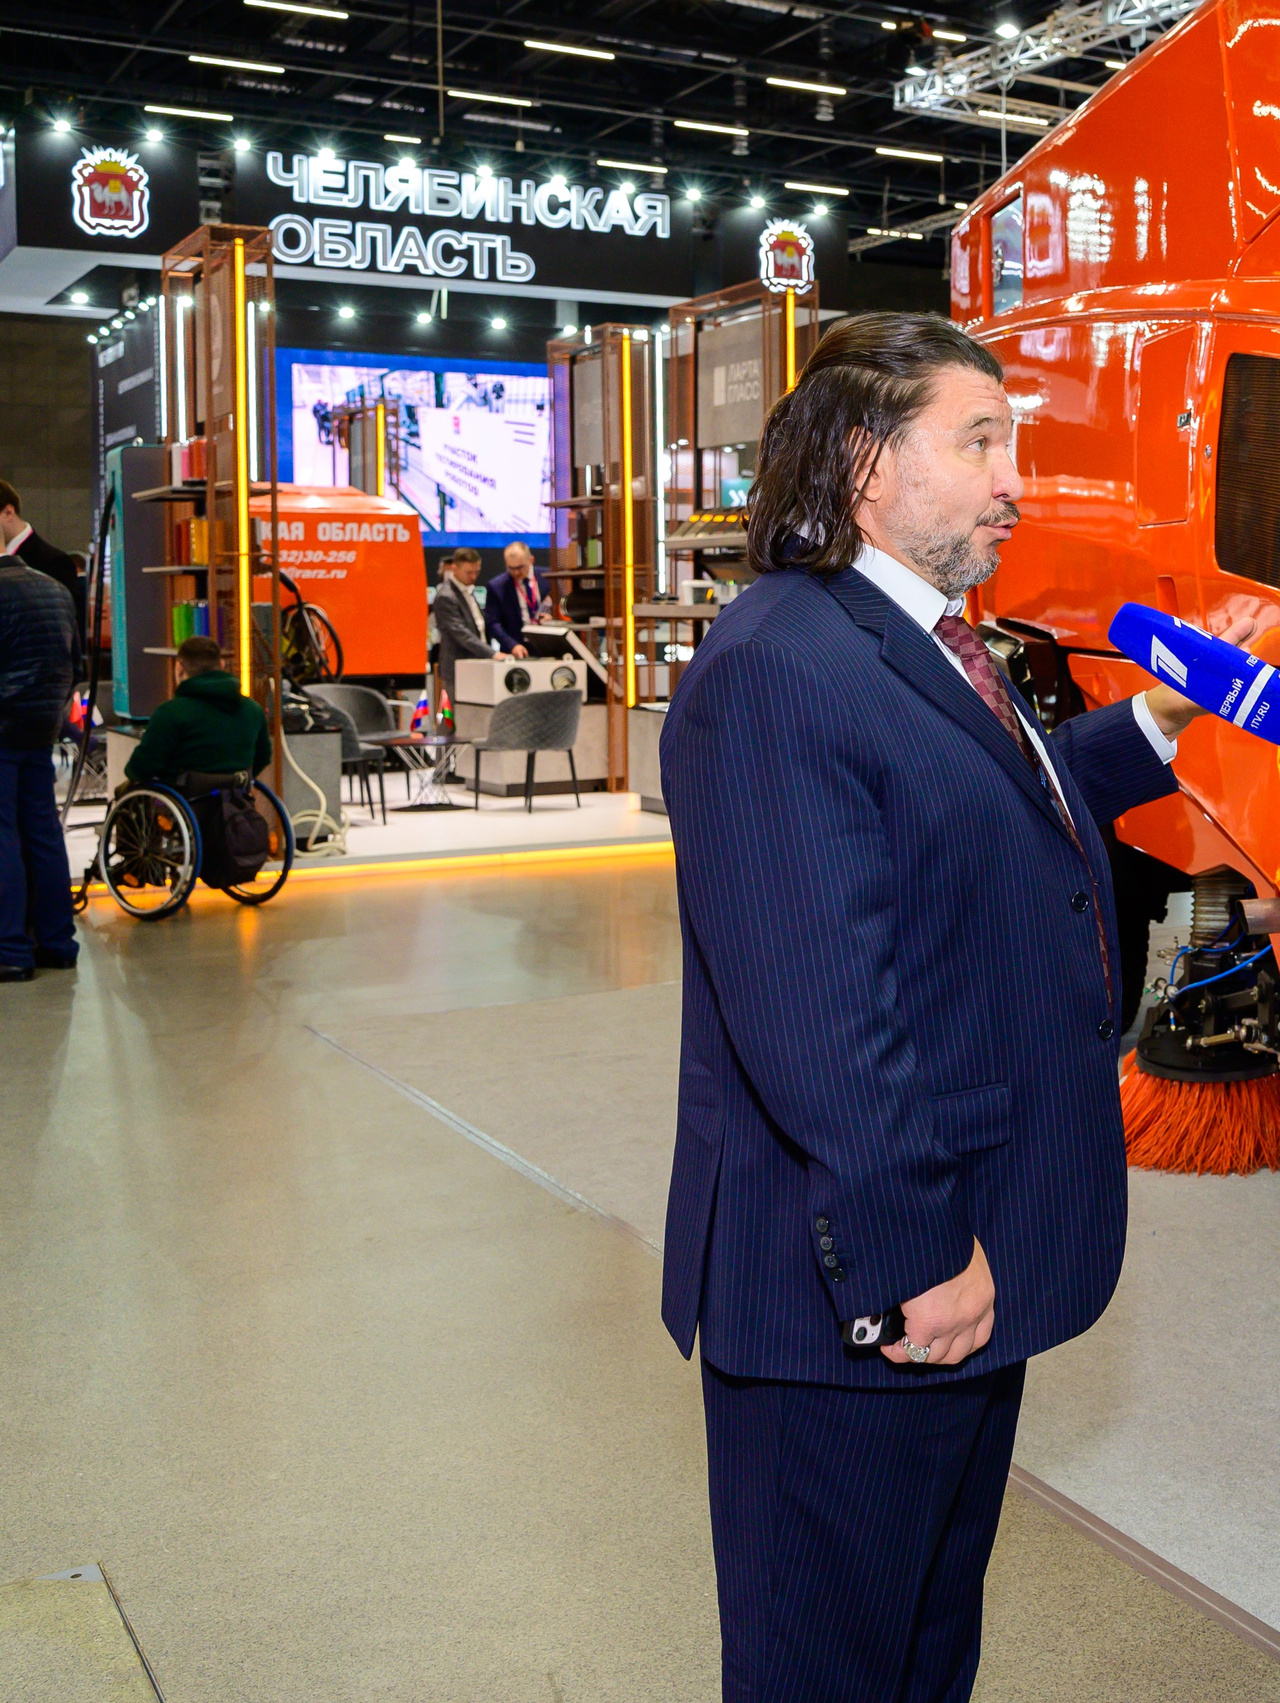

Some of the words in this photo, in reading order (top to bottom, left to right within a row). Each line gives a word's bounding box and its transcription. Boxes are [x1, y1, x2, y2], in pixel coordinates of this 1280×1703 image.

[267, 152, 671, 238] ЧЕЛЯБИНСКАЯ
[269, 214, 536, 282] ОБЛАСТЬ
[317, 522, 411, 542] ОБЛАСТЬ
[1219, 678, 1245, 717] ПЕРВЫЙ
[1251, 701, 1271, 729] 1TV.RU
